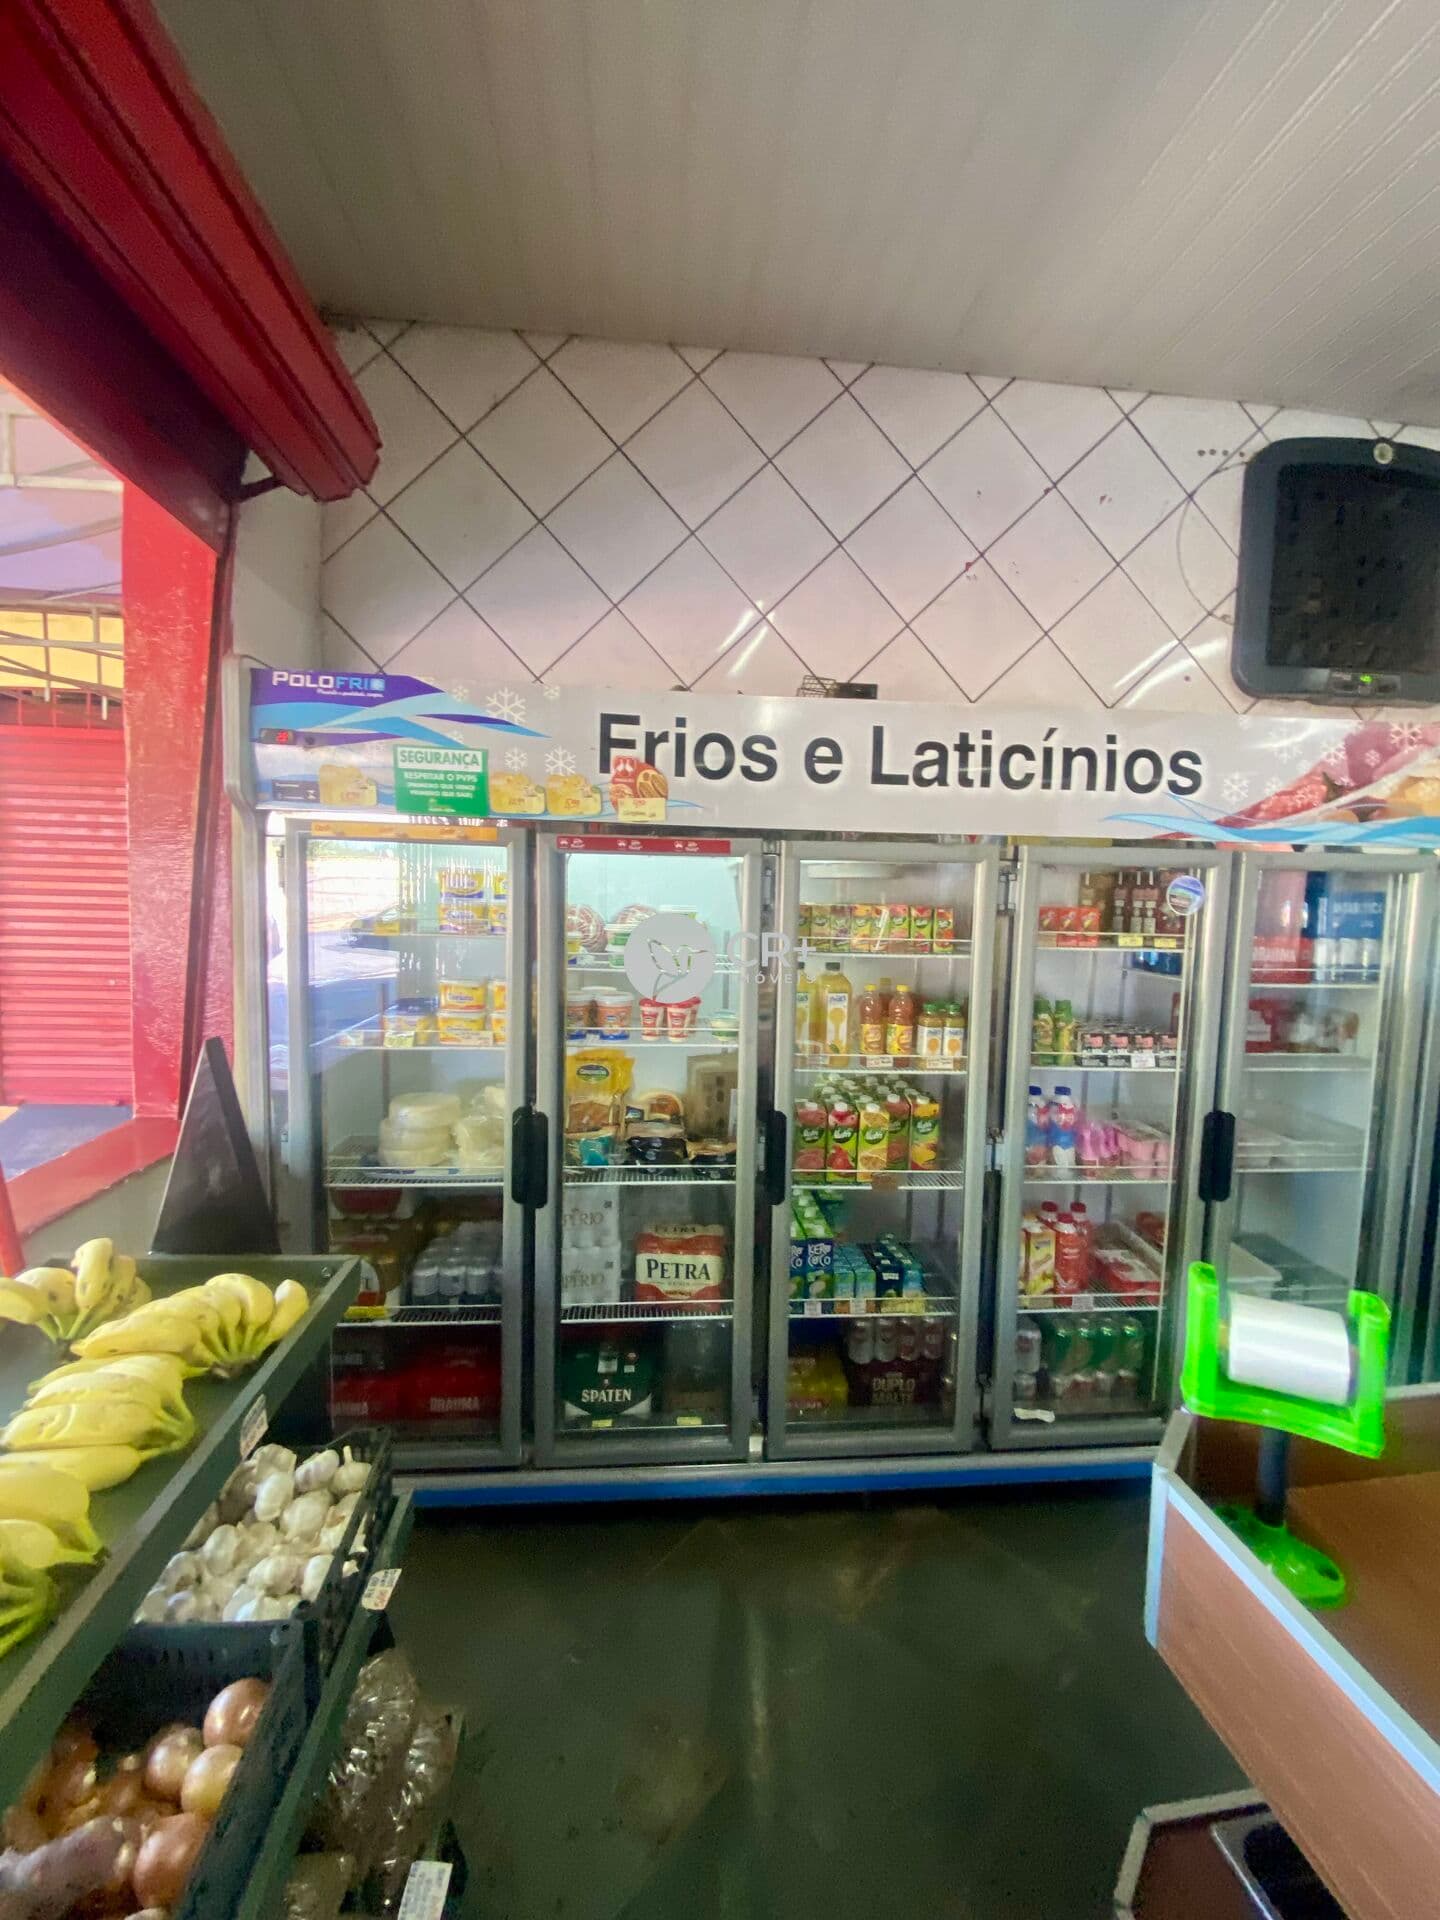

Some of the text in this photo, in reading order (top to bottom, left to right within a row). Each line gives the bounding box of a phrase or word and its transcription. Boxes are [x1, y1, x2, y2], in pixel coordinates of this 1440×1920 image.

[400, 750, 479, 769] SEGURANÇA
[599, 712, 1203, 796] Frios e Laticínios
[646, 1258, 711, 1281] PETRA
[581, 1389, 632, 1403] SPATEN
